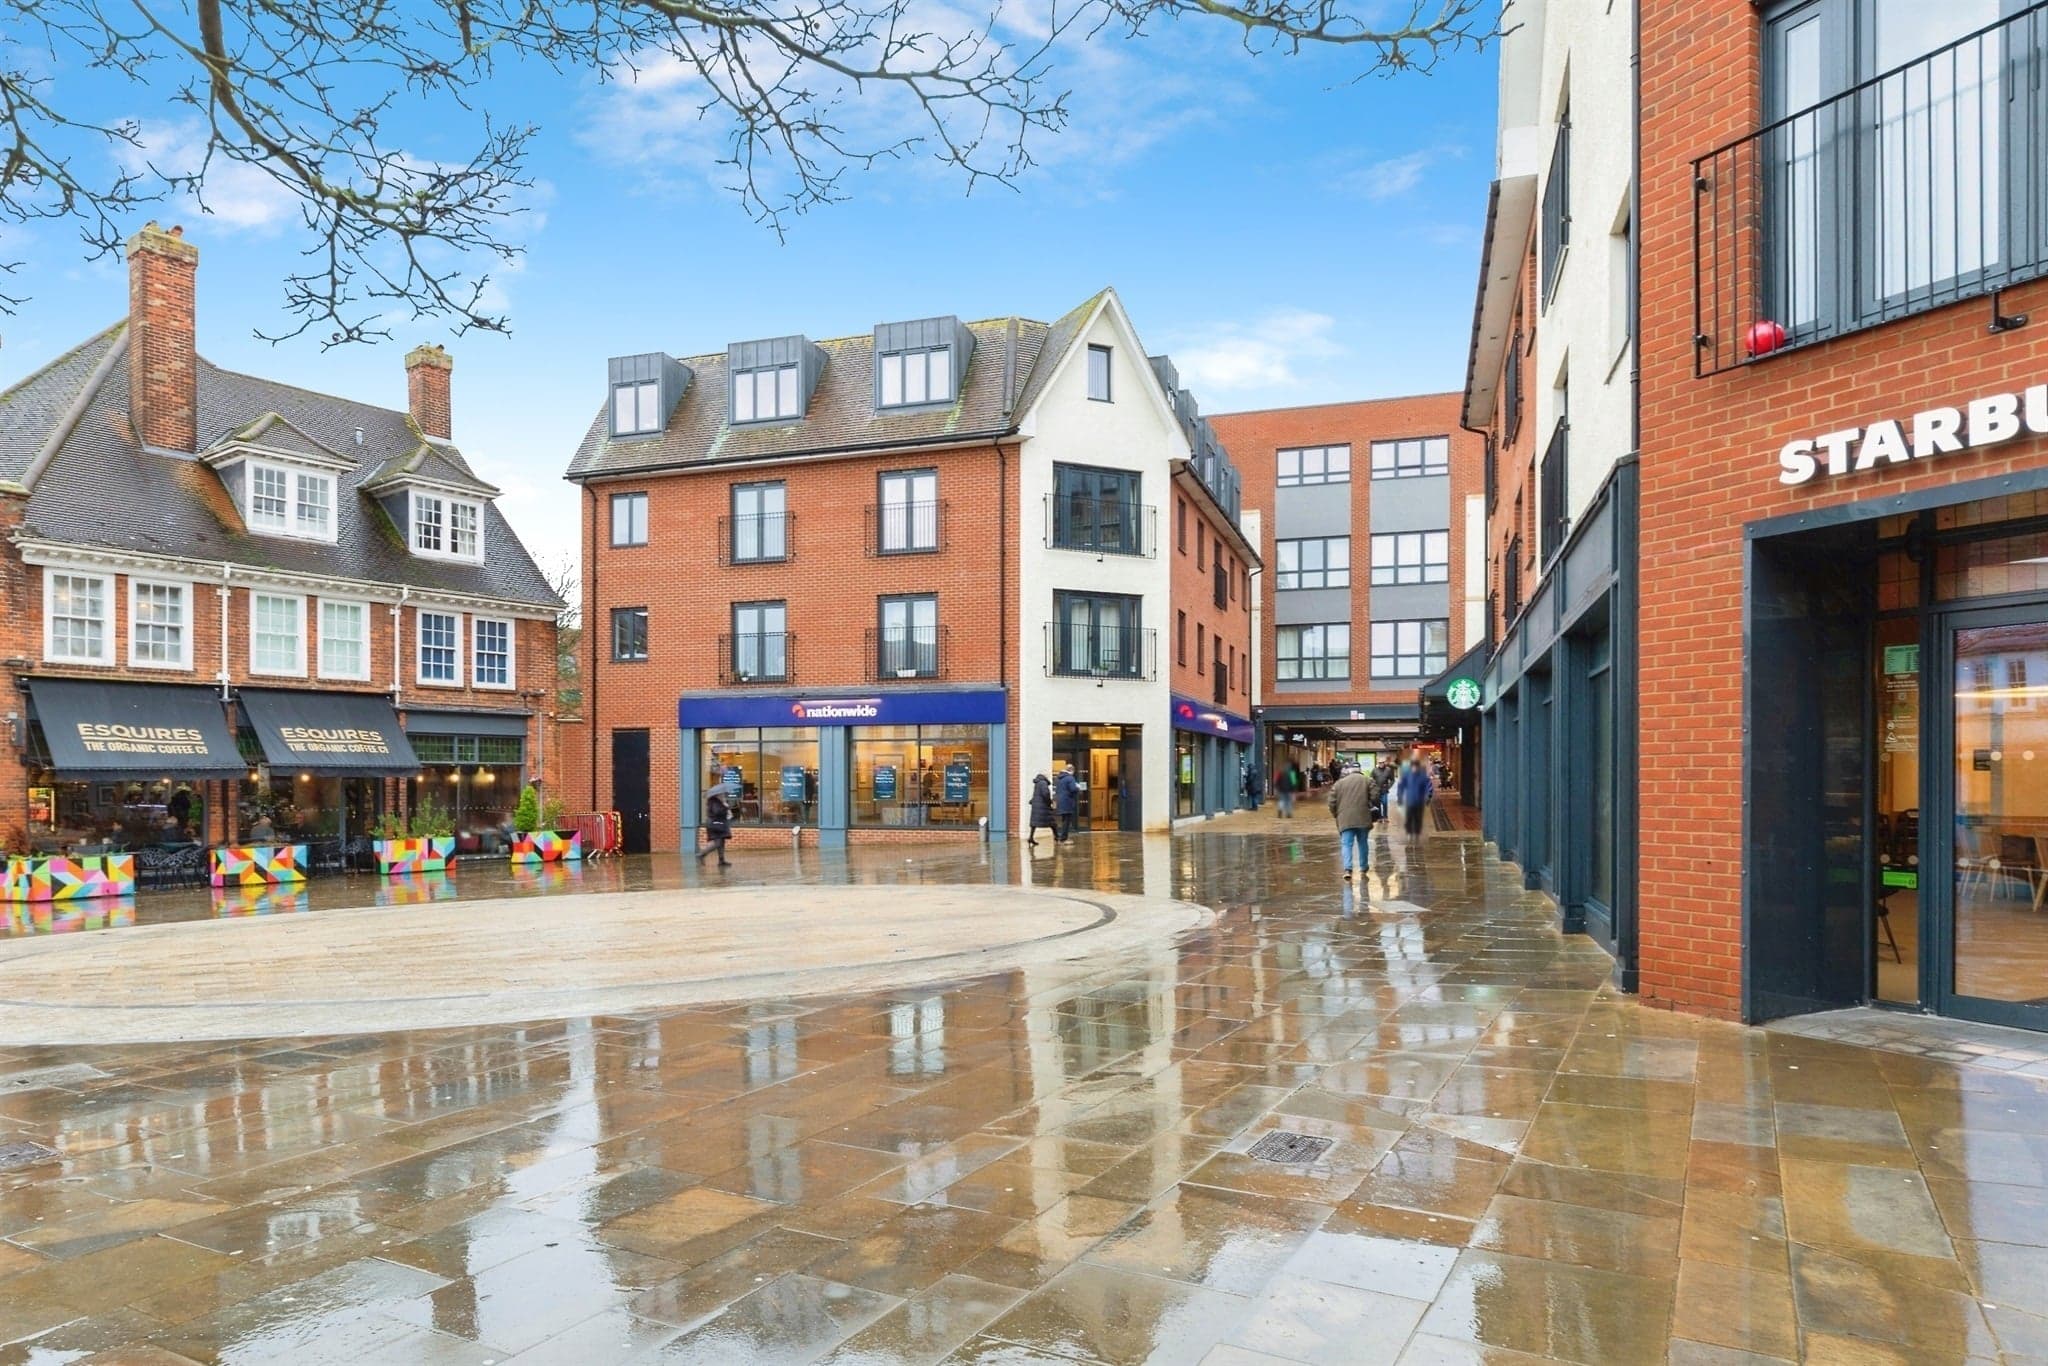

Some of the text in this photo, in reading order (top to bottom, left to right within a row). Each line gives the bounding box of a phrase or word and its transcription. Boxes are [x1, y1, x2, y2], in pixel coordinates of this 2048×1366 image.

[806, 705, 877, 718] nationwide
[77, 723, 203, 741] ESQUIRES
[280, 727, 383, 741] ESQUIRES
[84, 741, 107, 752] THE
[107, 742, 157, 753] ORGANIC
[157, 744, 195, 755] COFFEE
[288, 743, 307, 752] THE
[307, 743, 348, 753] ORGANIC
[348, 744, 378, 753] COFFEE
